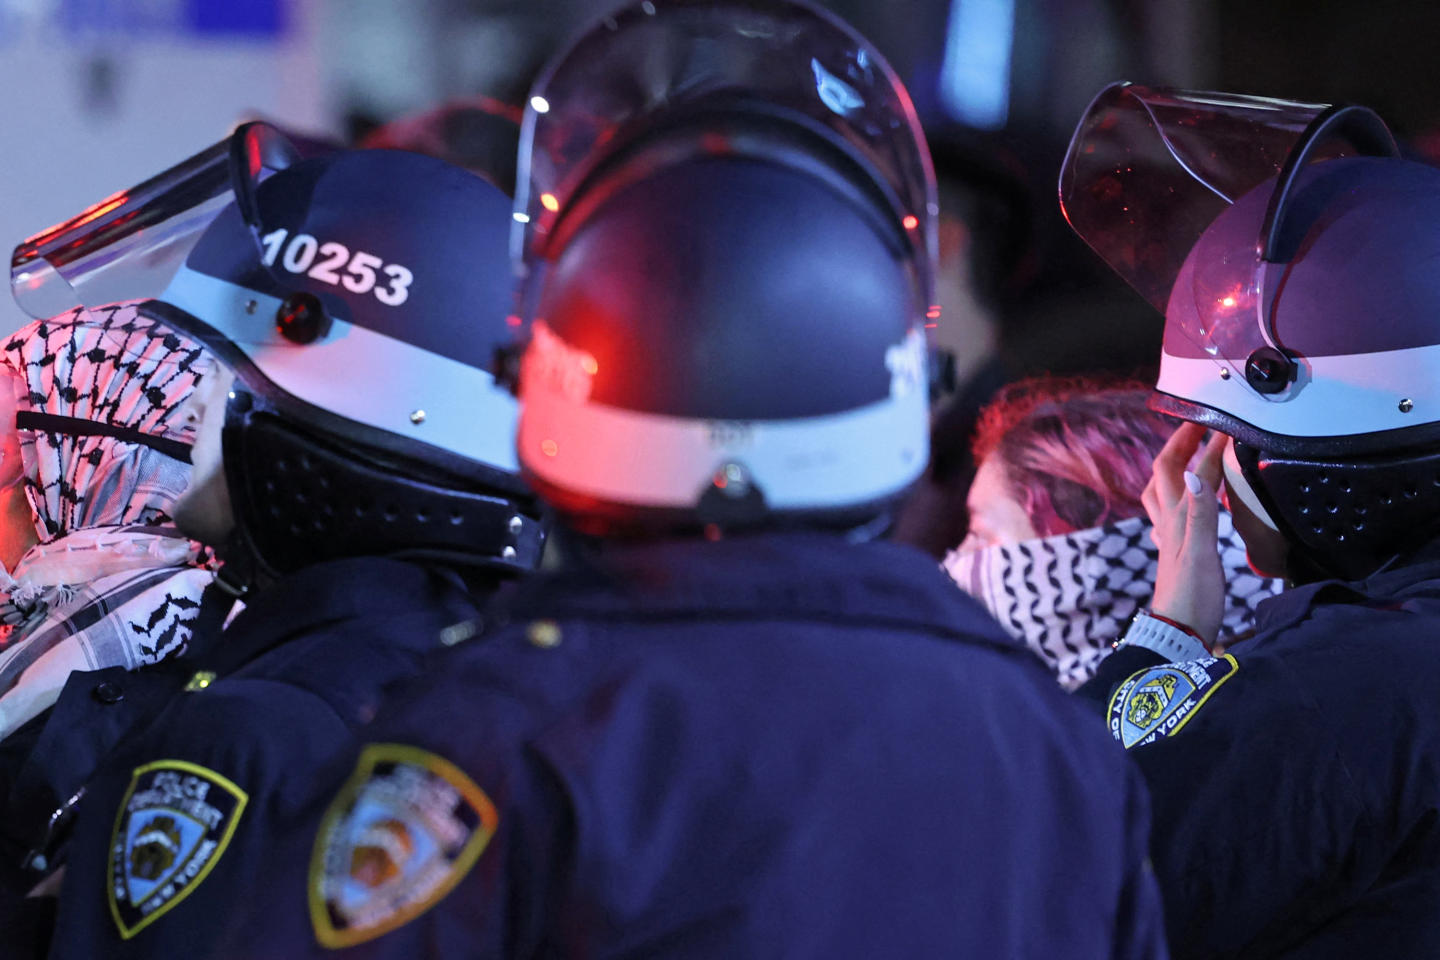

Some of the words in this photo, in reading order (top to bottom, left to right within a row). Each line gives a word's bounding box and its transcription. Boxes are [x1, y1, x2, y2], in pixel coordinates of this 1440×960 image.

[262, 228, 413, 306] 10253
[1111, 717, 1120, 740] OF
[1157, 697, 1196, 736] YORK
